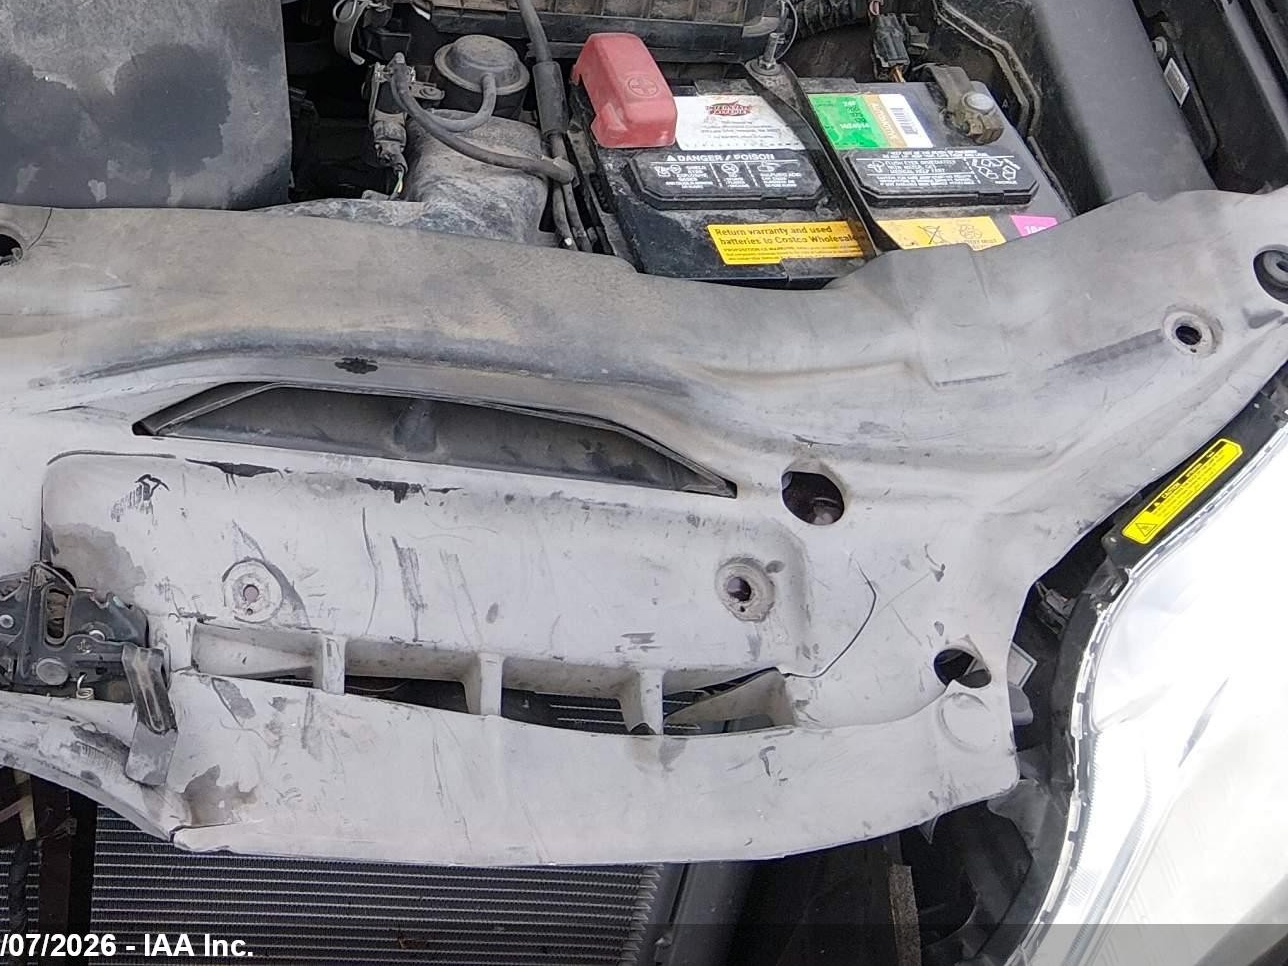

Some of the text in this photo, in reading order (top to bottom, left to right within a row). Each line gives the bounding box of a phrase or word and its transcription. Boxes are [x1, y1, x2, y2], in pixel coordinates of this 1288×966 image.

[677, 154, 723, 162] DANGER
[733, 153, 775, 161] POISON
[748, 228, 789, 236] warranty
[720, 237, 761, 245] batteries
